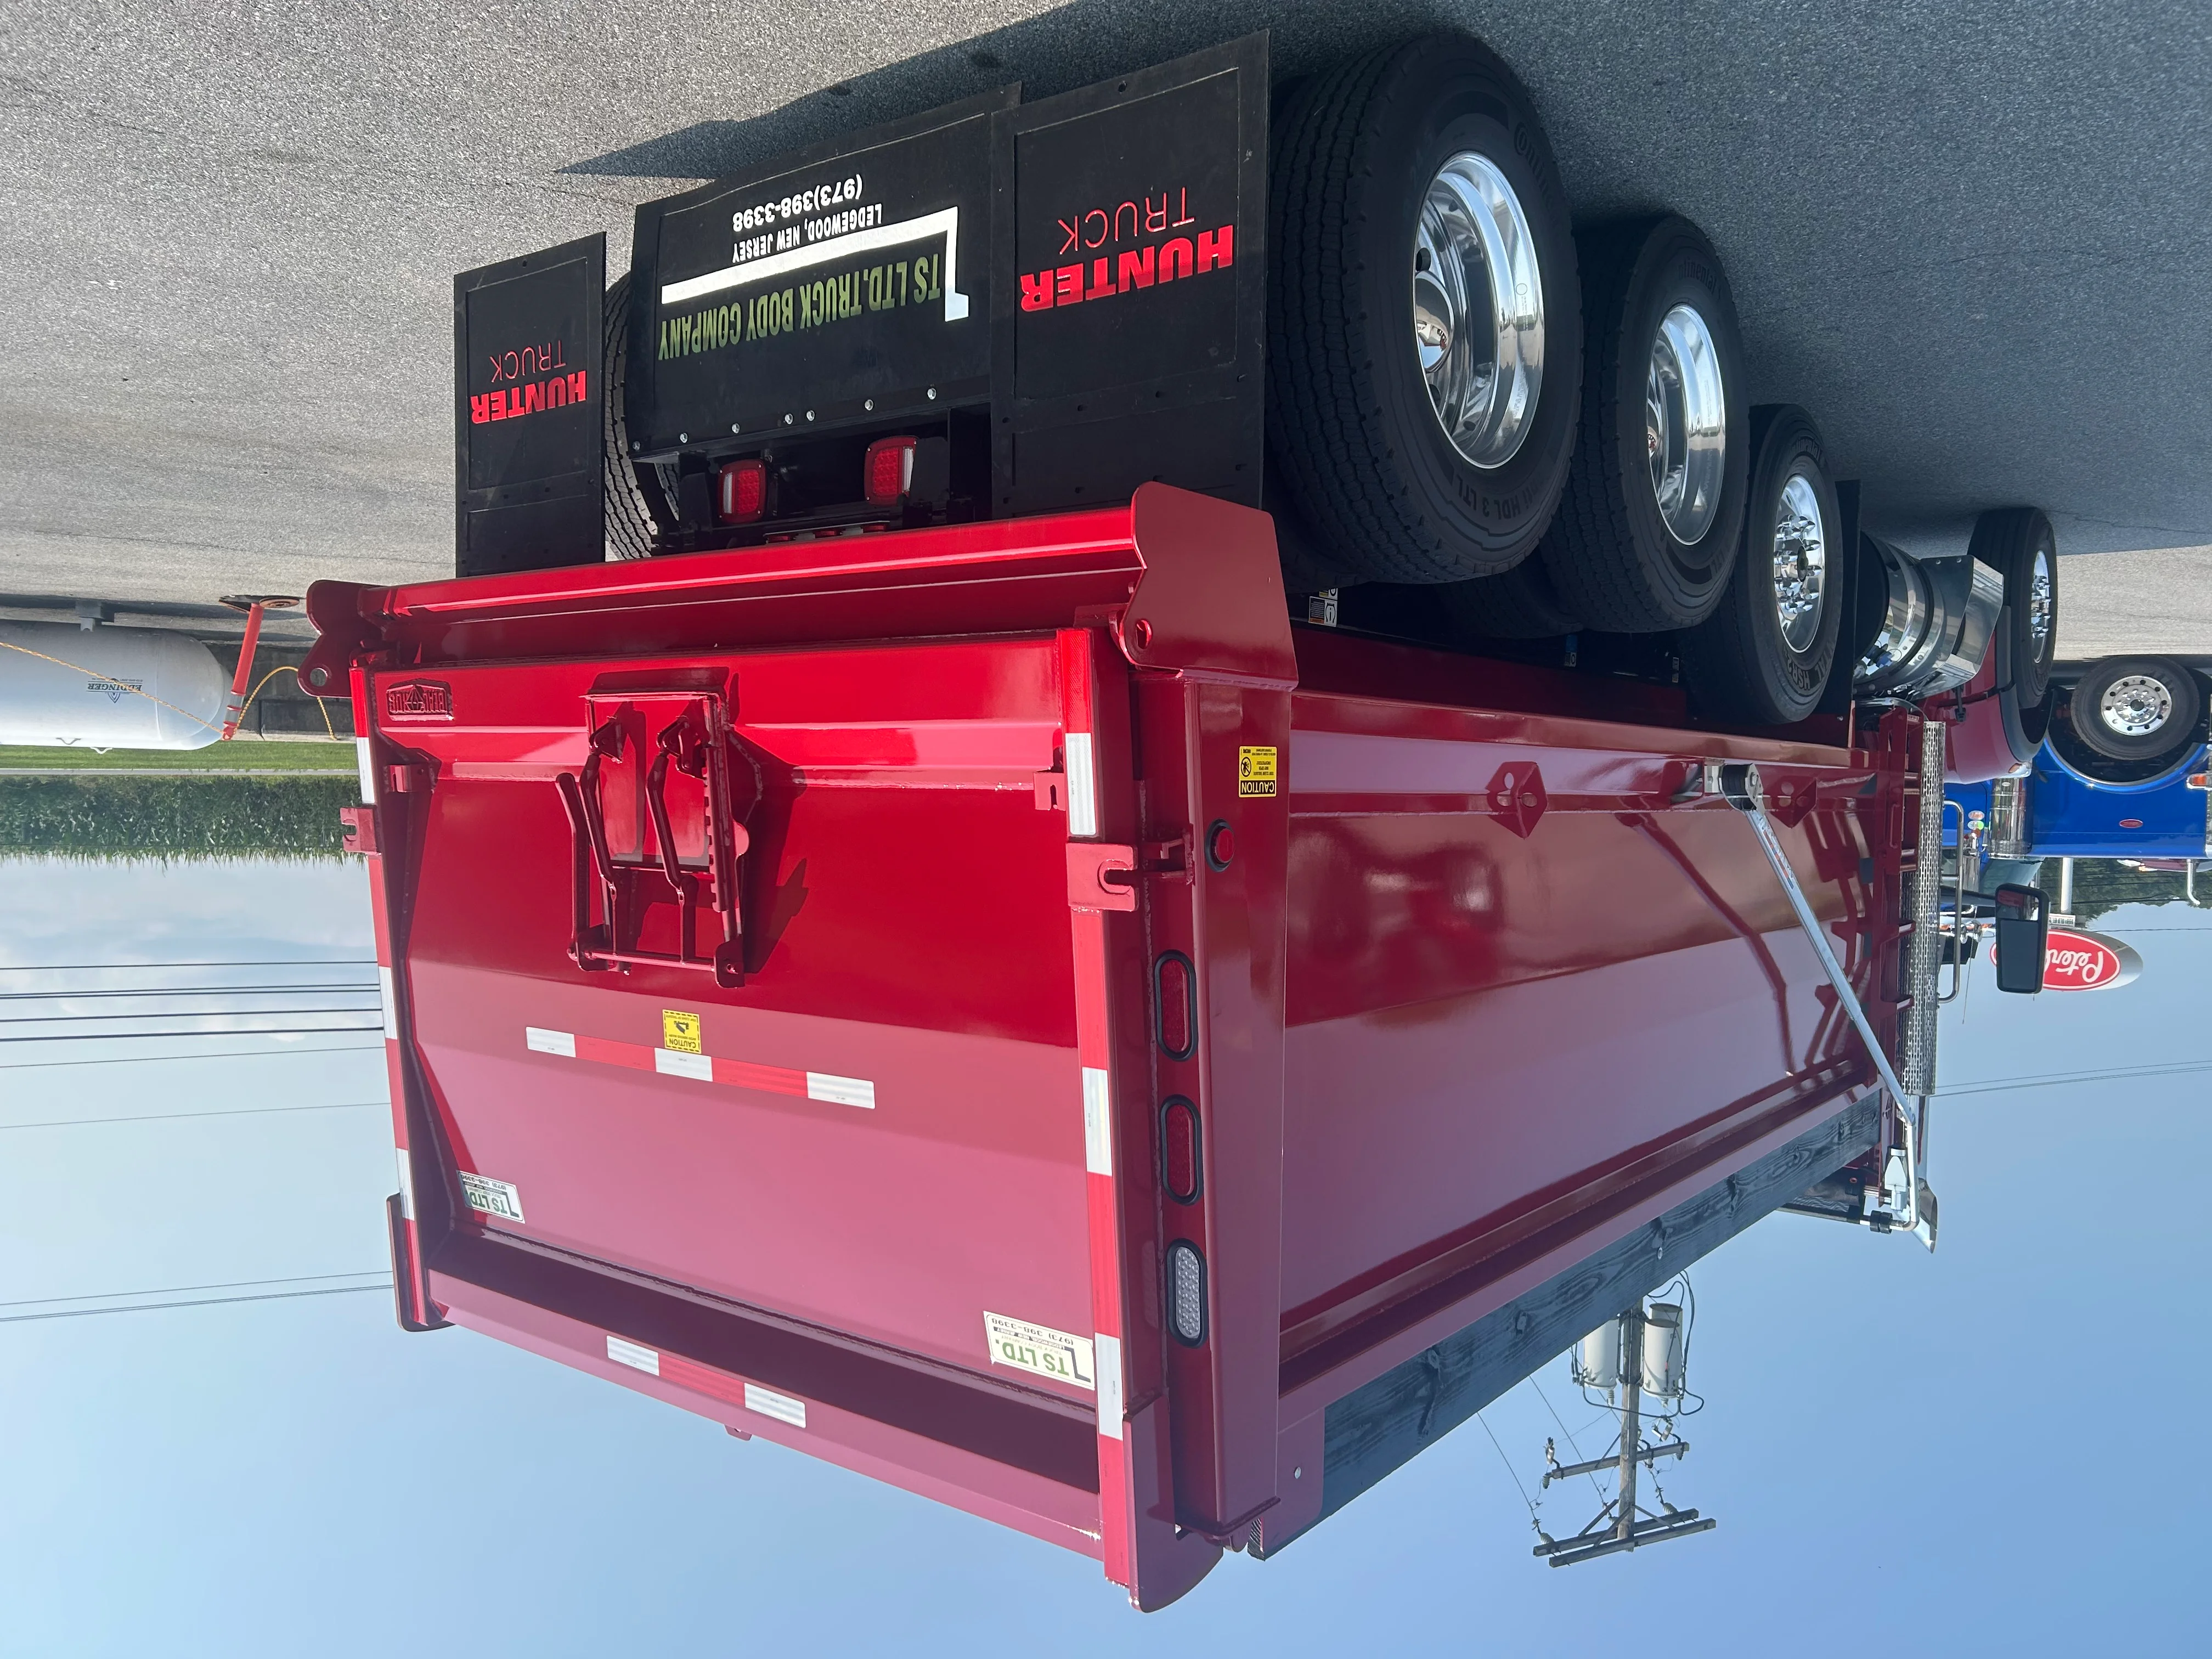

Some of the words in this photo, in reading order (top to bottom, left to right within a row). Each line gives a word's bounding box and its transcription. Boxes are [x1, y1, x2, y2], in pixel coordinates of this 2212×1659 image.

[732, 173, 863, 232] (973)398-3398
[776, 220, 800, 252] NEW
[804, 203, 883, 241] LEDGEWOOD,
[1057, 187, 1195, 255] TRUCK
[731, 232, 774, 263] JERSEY
[913, 253, 940, 304] TS
[1019, 224, 1234, 313] HUNTER
[658, 301, 742, 361] COMPANY
[746, 287, 794, 342] BODY
[489, 340, 567, 383] TRUCK
[470, 370, 587, 424] HUNTER
[1482, 497, 1490, 517] 3
[1241, 781, 1274, 793] CAUTION
[2044, 949, 2103, 983] Peter
[669, 1038, 696, 1048] CAUTION
[491, 1197, 508, 1215] TS
[991, 1318, 1042, 1337] 398-3398
[1048, 1333, 1074, 1346] (973)
[1043, 1352, 1069, 1376] TS
